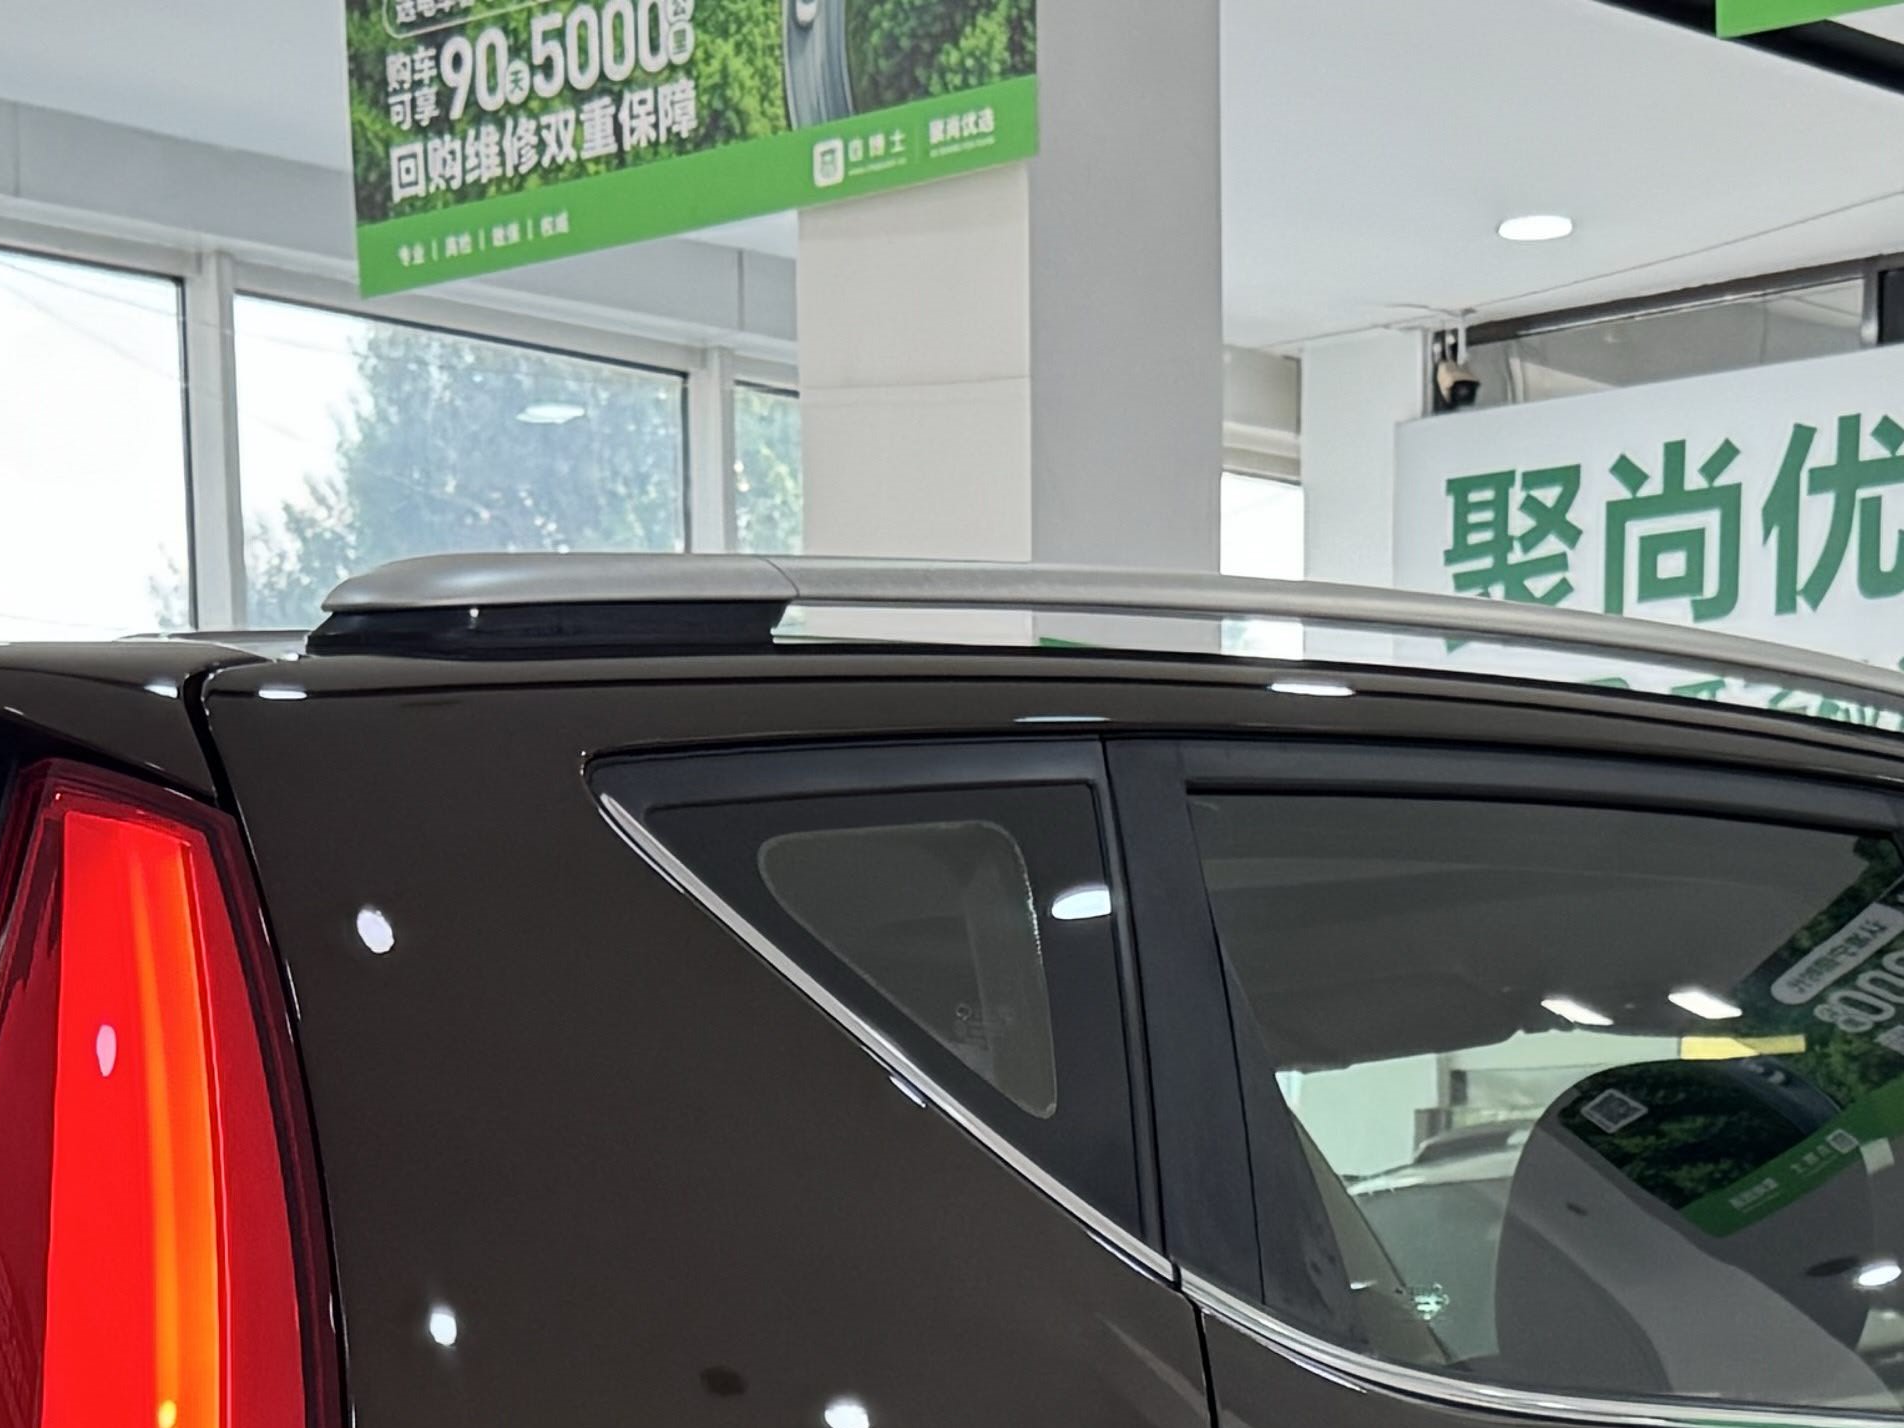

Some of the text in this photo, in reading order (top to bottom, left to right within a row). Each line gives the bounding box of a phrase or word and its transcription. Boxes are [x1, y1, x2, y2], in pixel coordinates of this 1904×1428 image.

[386, 46, 438, 93] 购车
[387, 86, 441, 131] 可享
[388, 76, 699, 204] 回购维修双重保障
